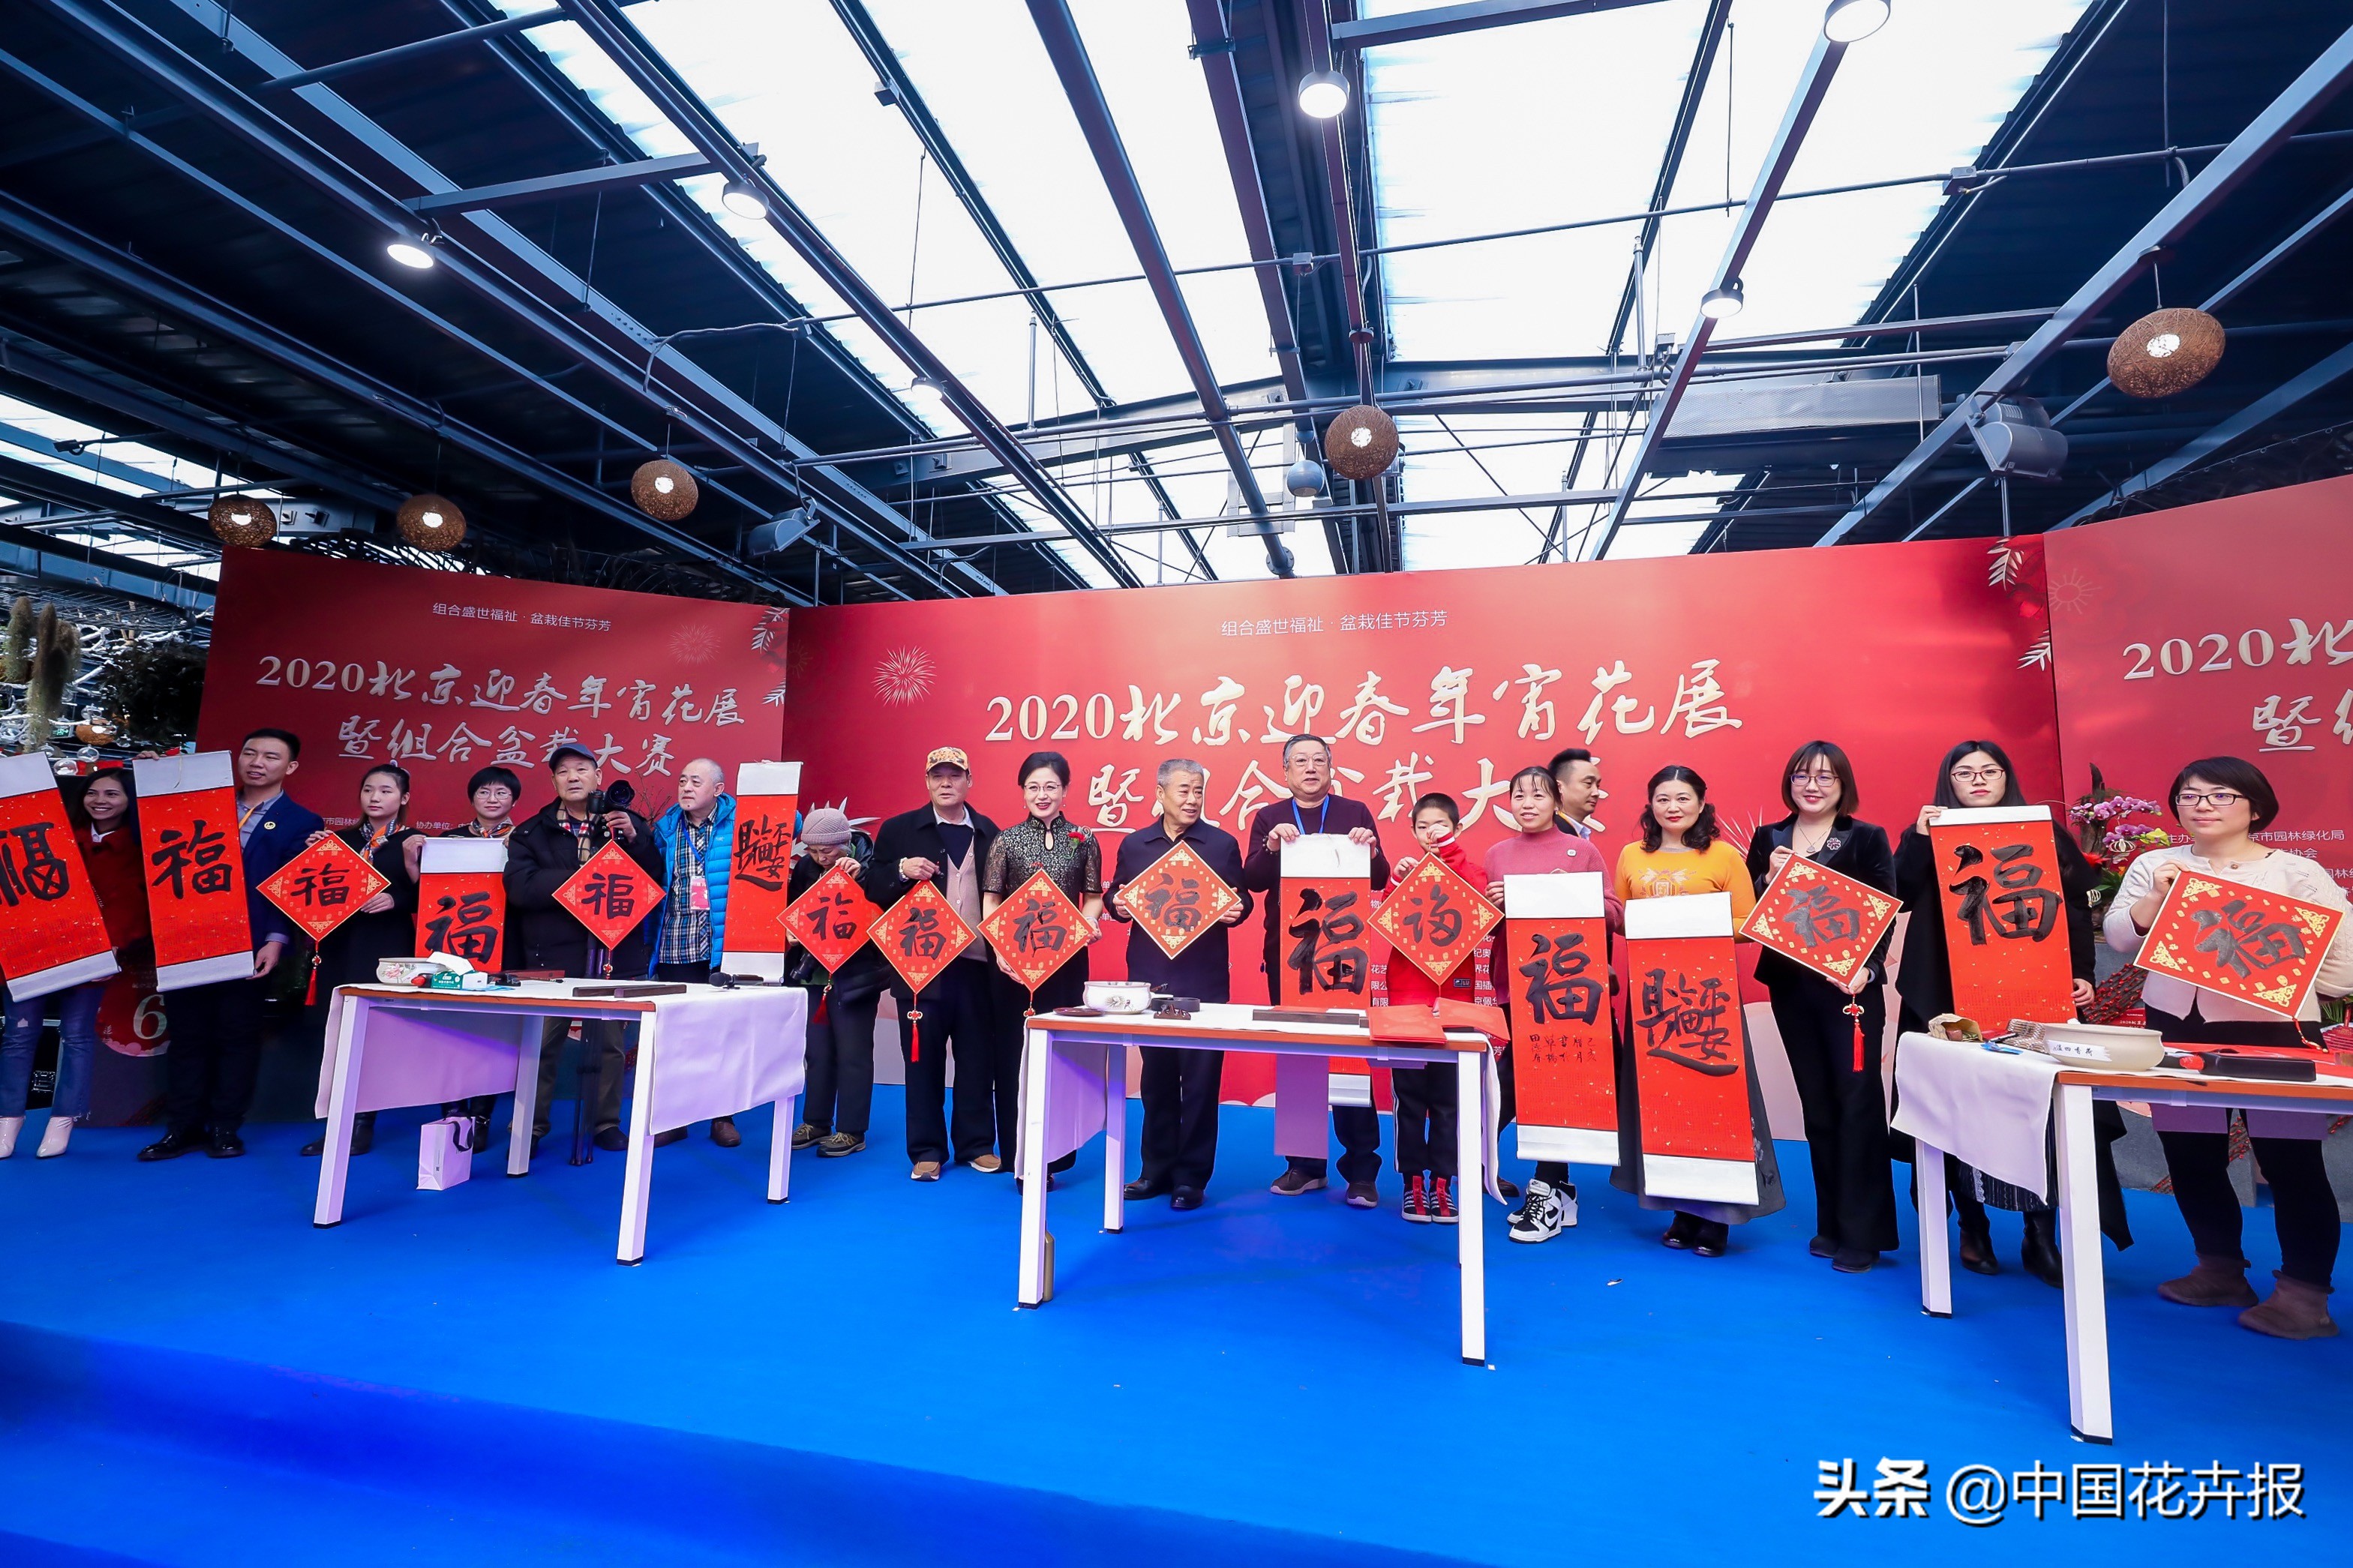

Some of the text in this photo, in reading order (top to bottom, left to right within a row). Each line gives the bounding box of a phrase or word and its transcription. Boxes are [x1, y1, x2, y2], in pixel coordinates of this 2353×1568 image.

[433, 602, 611, 631] 组合盛世福祉 盆栽佳节芬芳
[1221, 610, 1448, 636] 组合盛世福祉 盆栽佳节芬芳
[255, 655, 746, 727] 2020北京迎春年宵花展
[985, 658, 1743, 748] 2020北京迎春年宵花展
[152, 820, 233, 899] 福
[290, 863, 350, 907] 福
[425, 890, 499, 965] 福
[806, 892, 857, 941] 福
[1013, 899, 1067, 958] 福
[1144, 872, 1202, 932] 福
[1783, 884, 1861, 947] 福
[1949, 844, 2063, 946] 福
[899, 907, 947, 961] 福
[1287, 887, 1370, 996] 福
[2189, 899, 2307, 980] 福
[1519, 933, 1604, 1027] 福
